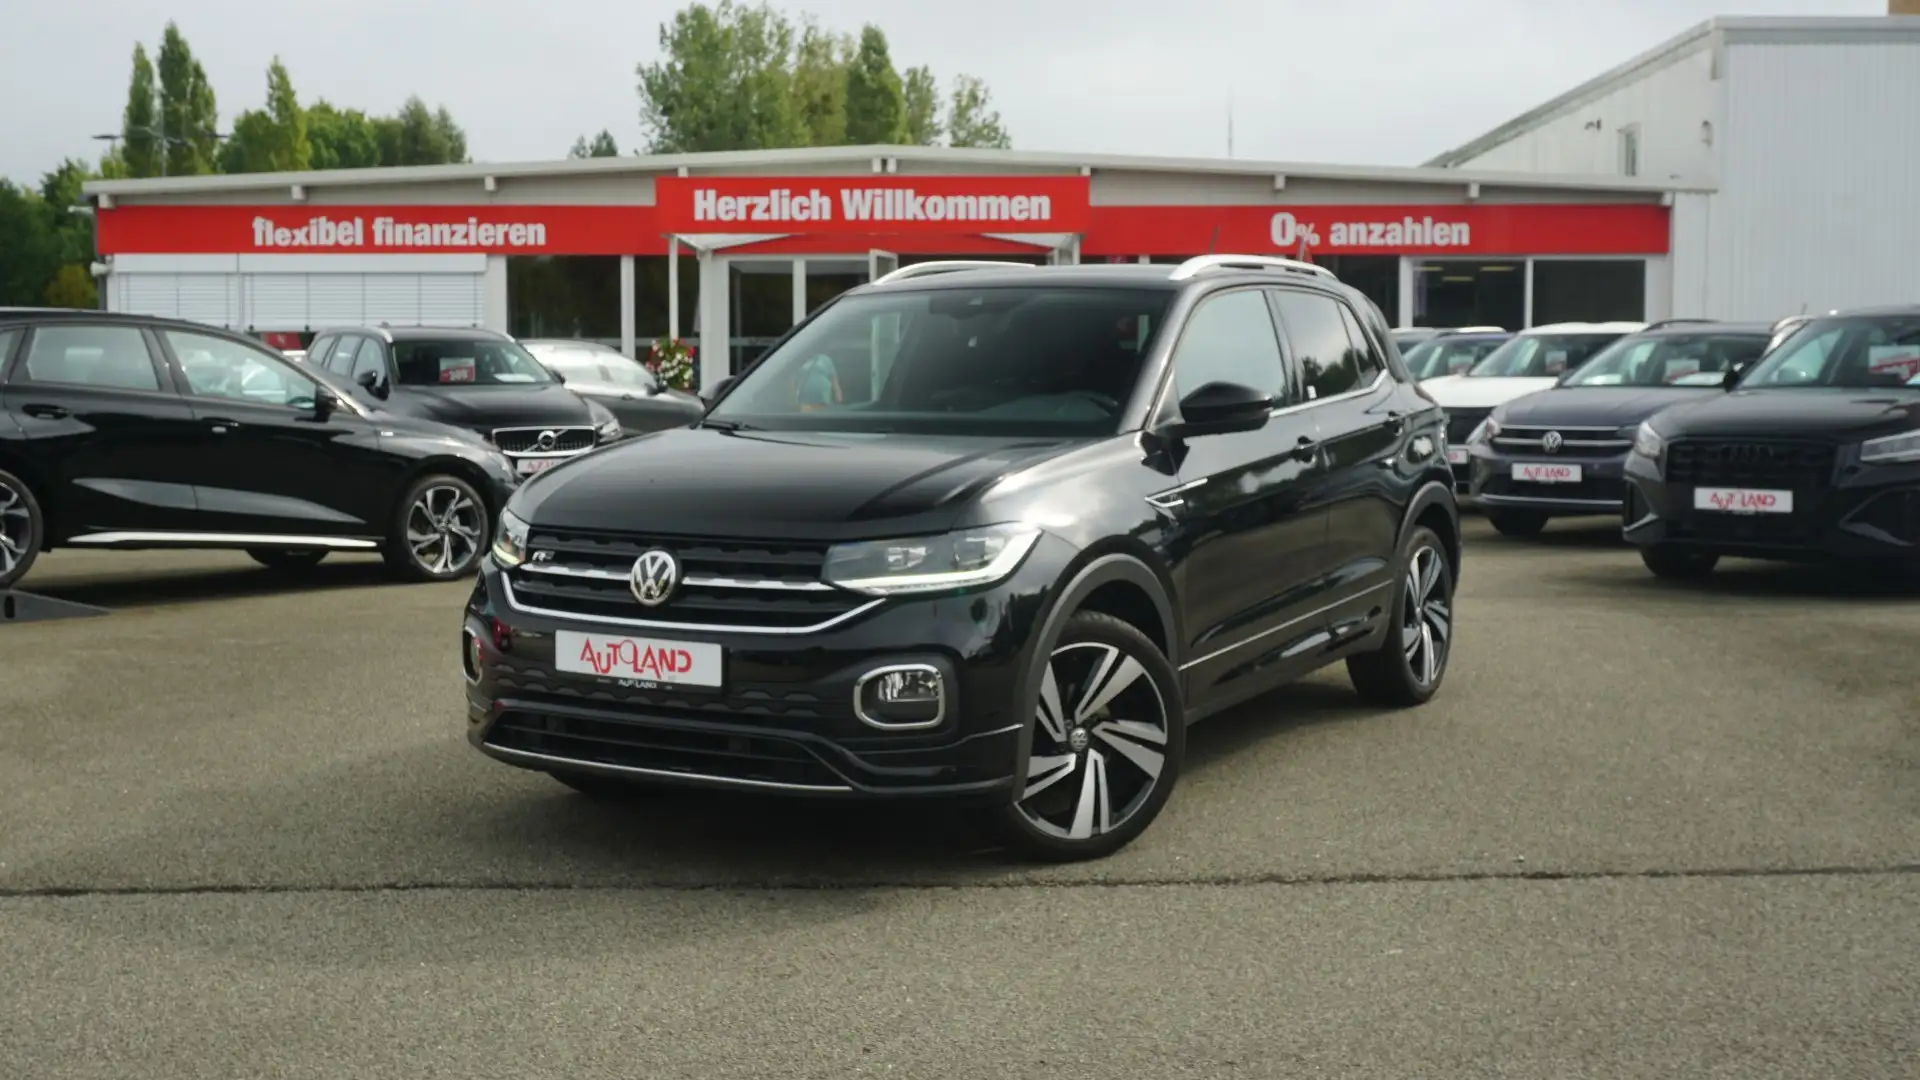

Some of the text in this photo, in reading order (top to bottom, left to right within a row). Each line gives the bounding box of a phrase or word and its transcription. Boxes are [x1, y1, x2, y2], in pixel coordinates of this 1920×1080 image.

[693, 189, 1051, 221] Herzlich Willkommen
[252, 216, 546, 247] flexibel finanzieren
[1270, 212, 1470, 247] 0% anzahlen
